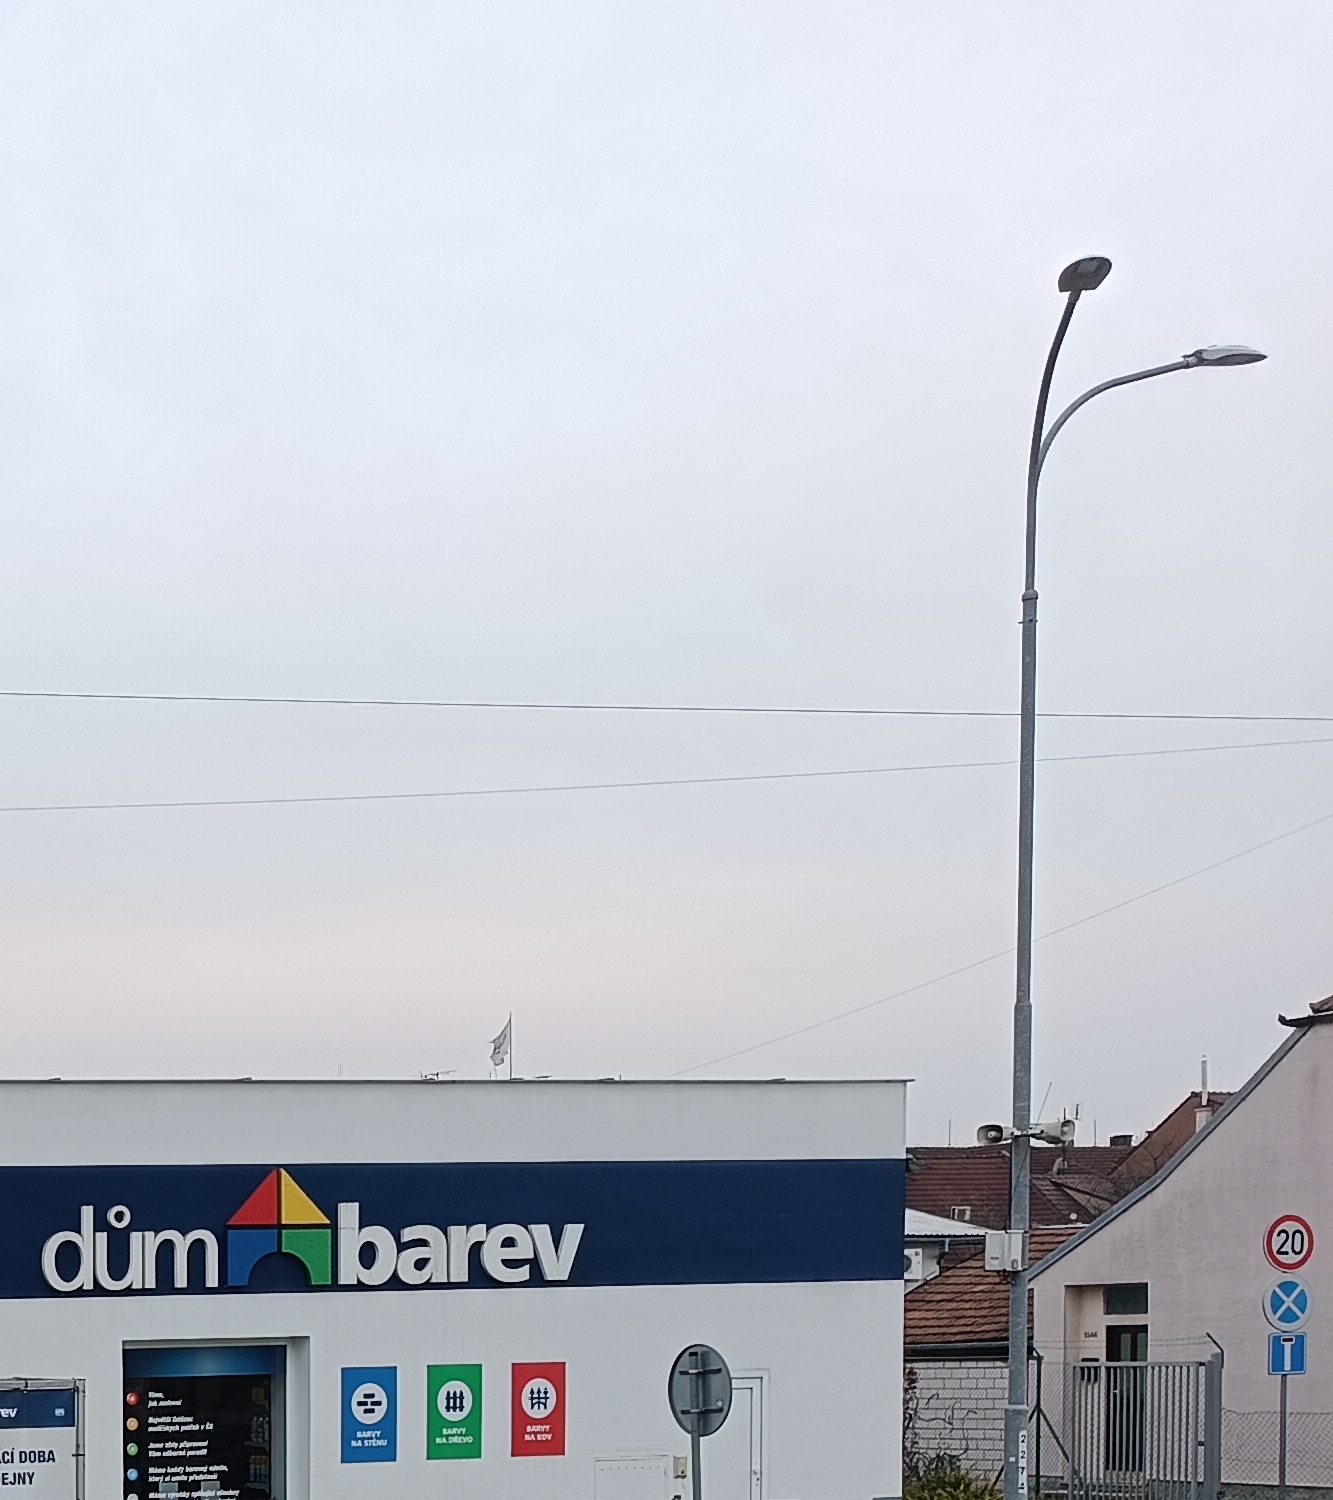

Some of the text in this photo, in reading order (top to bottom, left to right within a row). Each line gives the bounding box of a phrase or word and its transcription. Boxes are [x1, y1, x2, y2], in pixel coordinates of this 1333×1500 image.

[41, 1201, 585, 1292] dům barev
[1276, 1229, 1304, 1255] 20
[19, 1450, 56, 1464] DOBA
